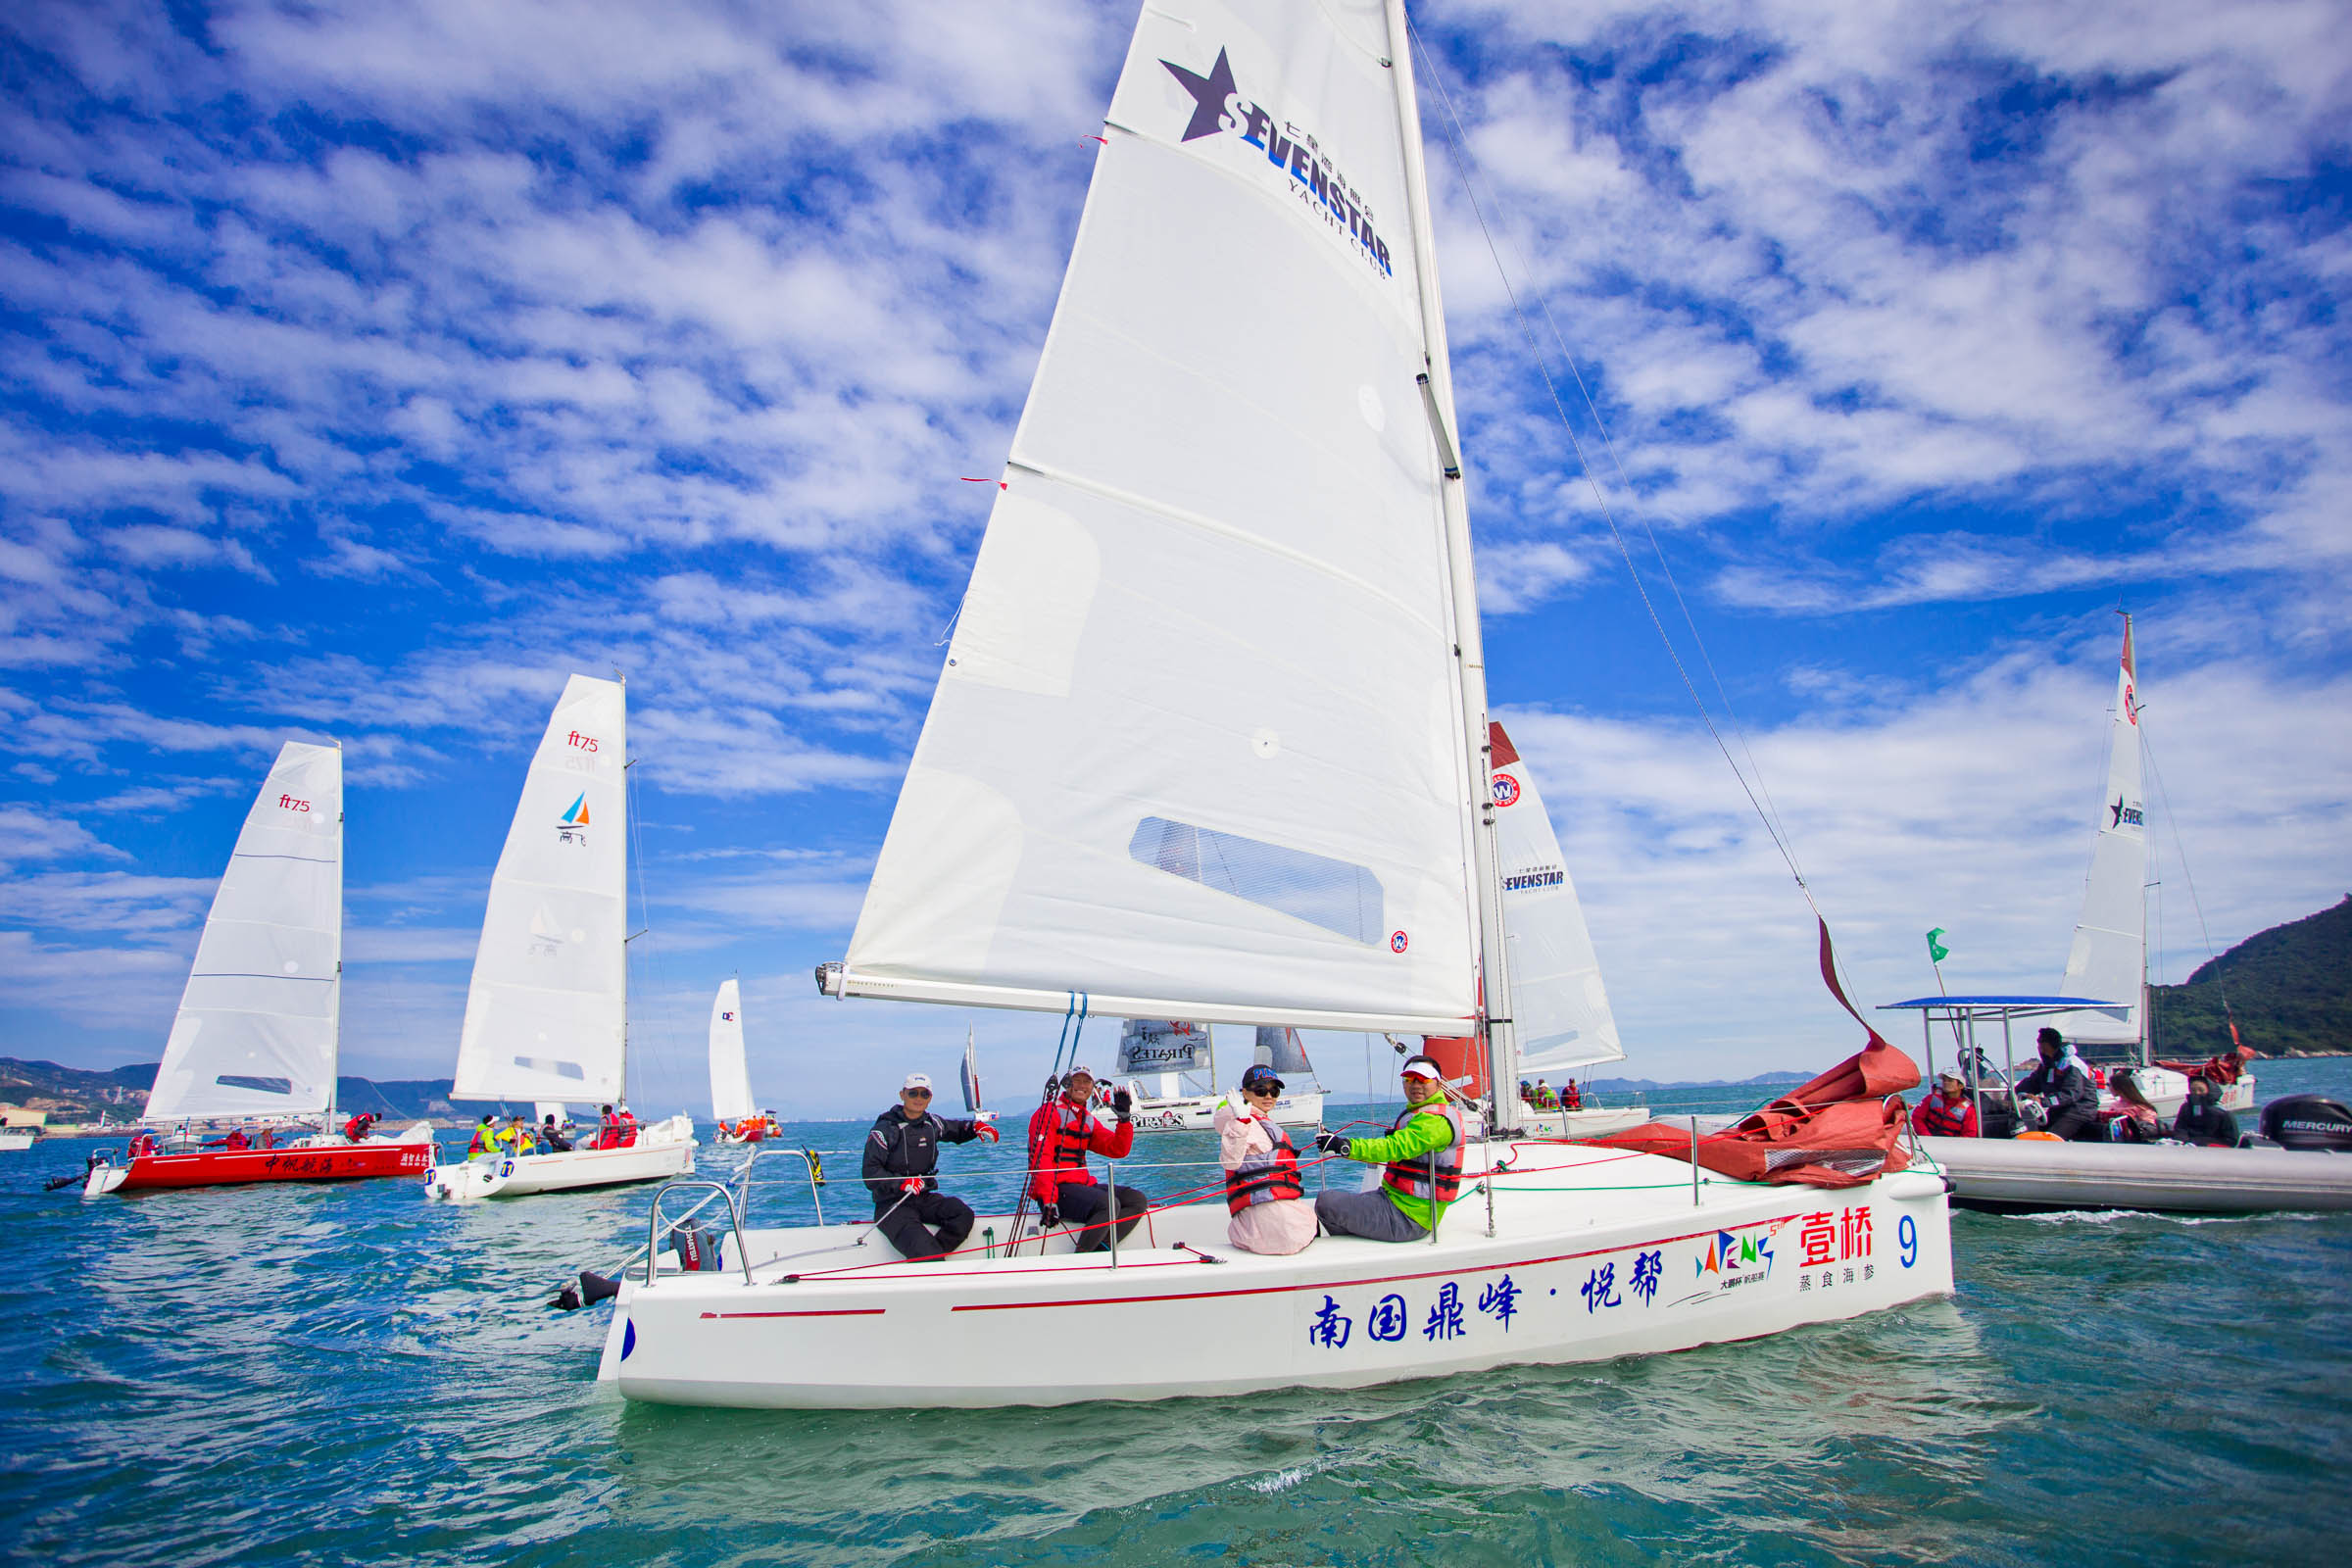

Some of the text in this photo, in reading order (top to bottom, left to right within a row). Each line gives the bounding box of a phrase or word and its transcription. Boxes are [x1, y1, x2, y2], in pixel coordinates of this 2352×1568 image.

[1218, 92, 1393, 277] SEVENSTAR
[1289, 178, 1386, 280] YACHT CLUB
[2282, 1120, 2352, 1134] MERCURY
[424, 1172, 436, 1184] 11
[503, 1164, 514, 1176] 11
[1898, 1215, 1918, 1269] 9
